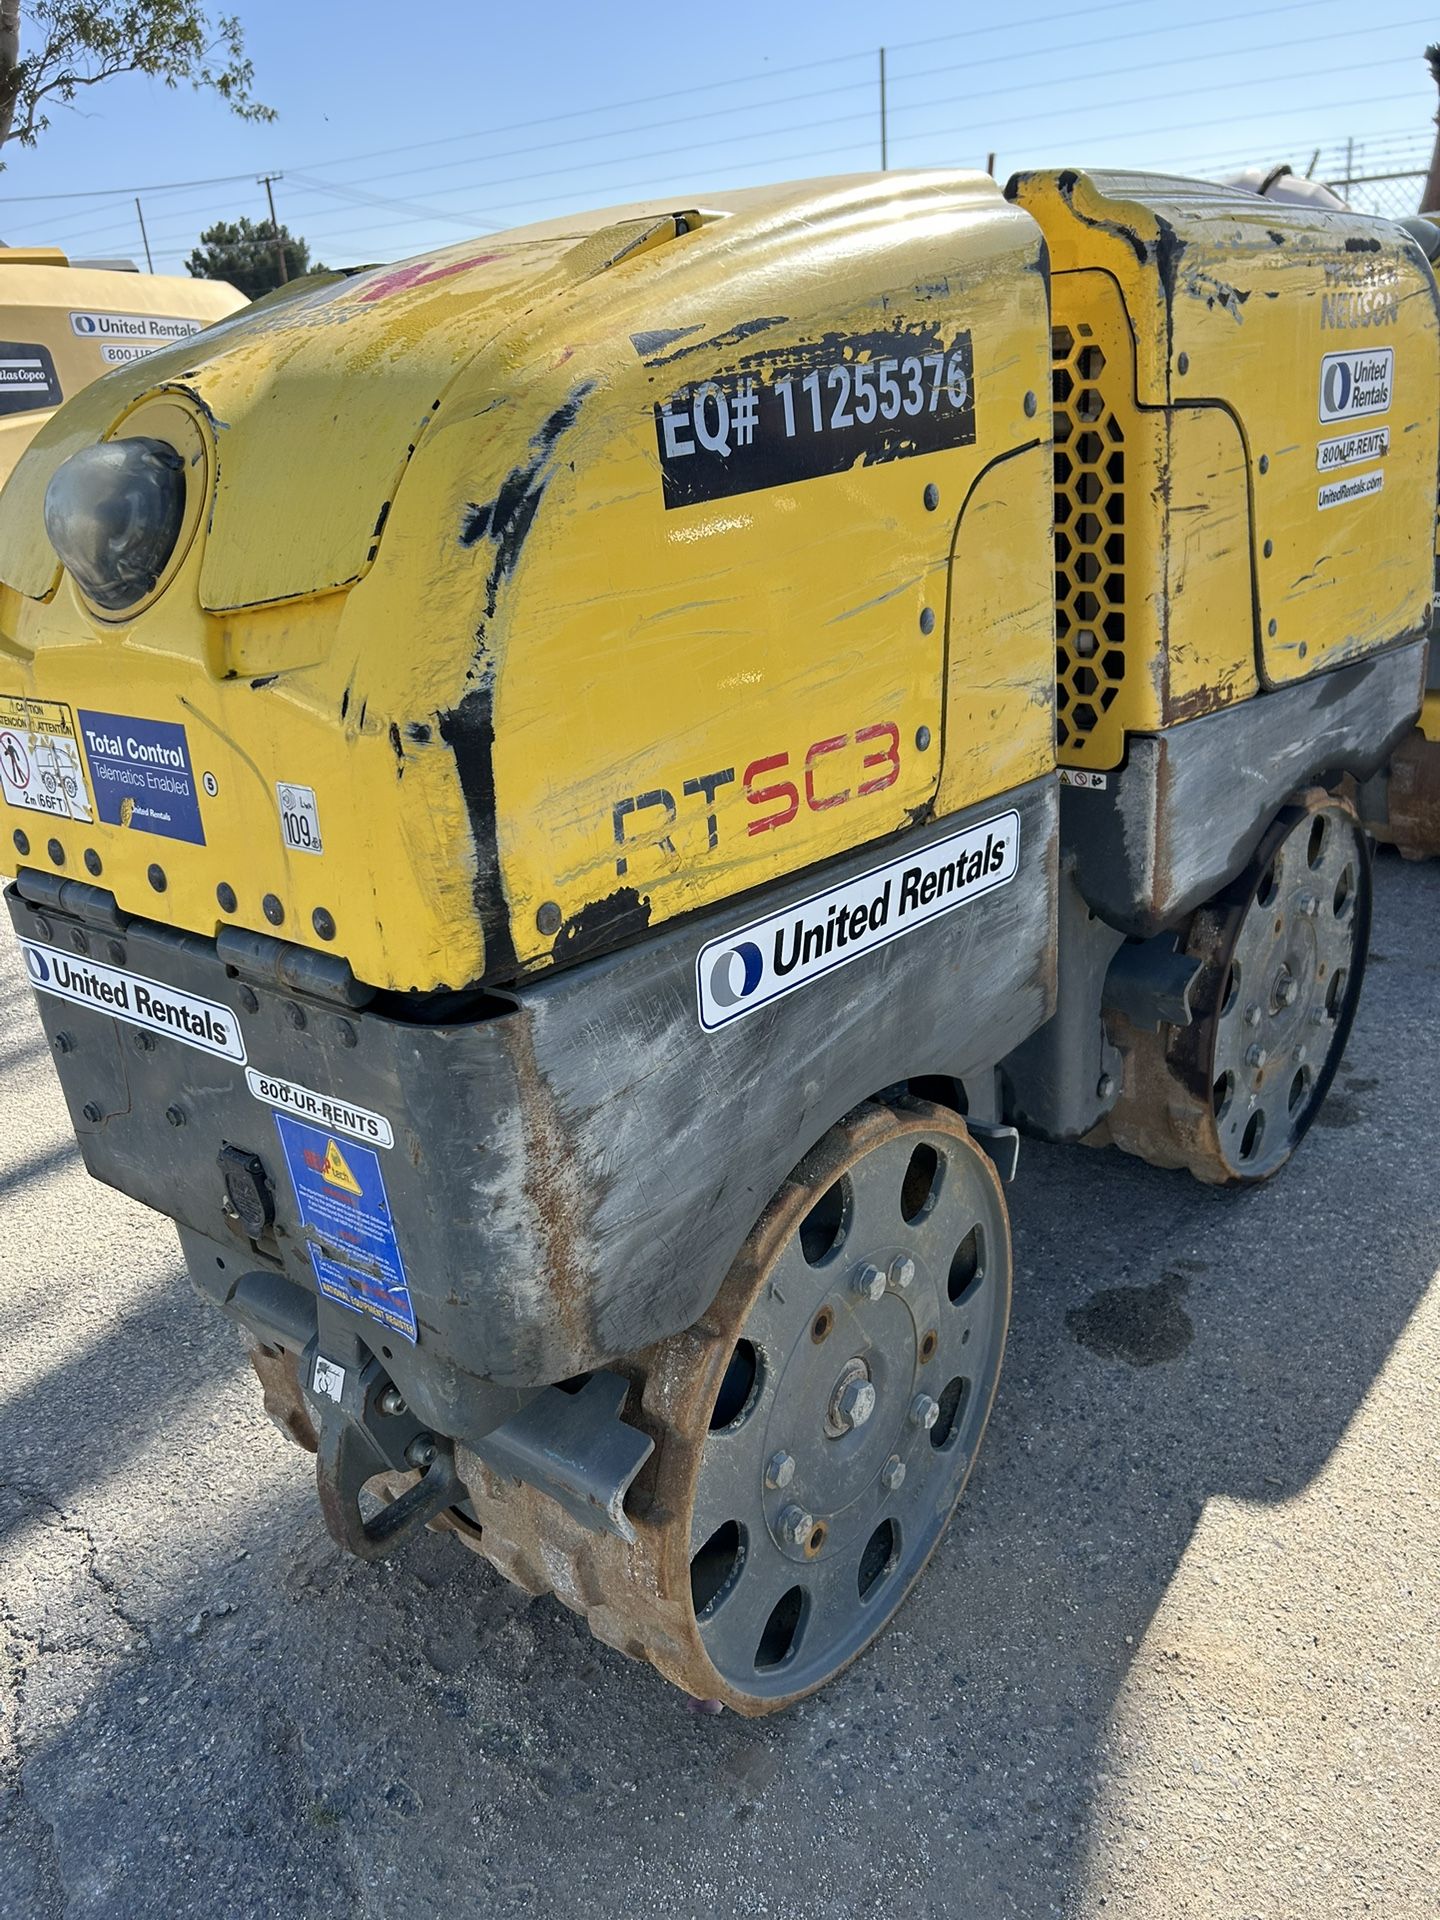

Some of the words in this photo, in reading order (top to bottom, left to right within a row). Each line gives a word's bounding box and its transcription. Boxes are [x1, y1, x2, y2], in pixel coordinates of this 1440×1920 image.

[98, 318, 146, 335] United
[149, 321, 197, 337] Rentals
[1353, 358, 1388, 383] United
[659, 377, 760, 458] EQ#
[774, 350, 969, 438] 11255376
[1351, 382, 1388, 408] Rentals
[1322, 433, 1385, 464] 800UR-RENTS
[1318, 475, 1383, 506] UnitedRentals.com
[86, 730, 123, 757] Total
[127, 737, 185, 768] Control
[93, 761, 145, 787] Telematics
[148, 771, 190, 796] Enabled
[207, 777, 214, 791] 5
[283, 811, 311, 847] 109
[773, 878, 892, 977] United
[898, 833, 1006, 917] Rentals
[52, 957, 130, 1010] United
[134, 984, 228, 1046] Rentals
[259, 1079, 379, 1137] 800-UR-RENTS
